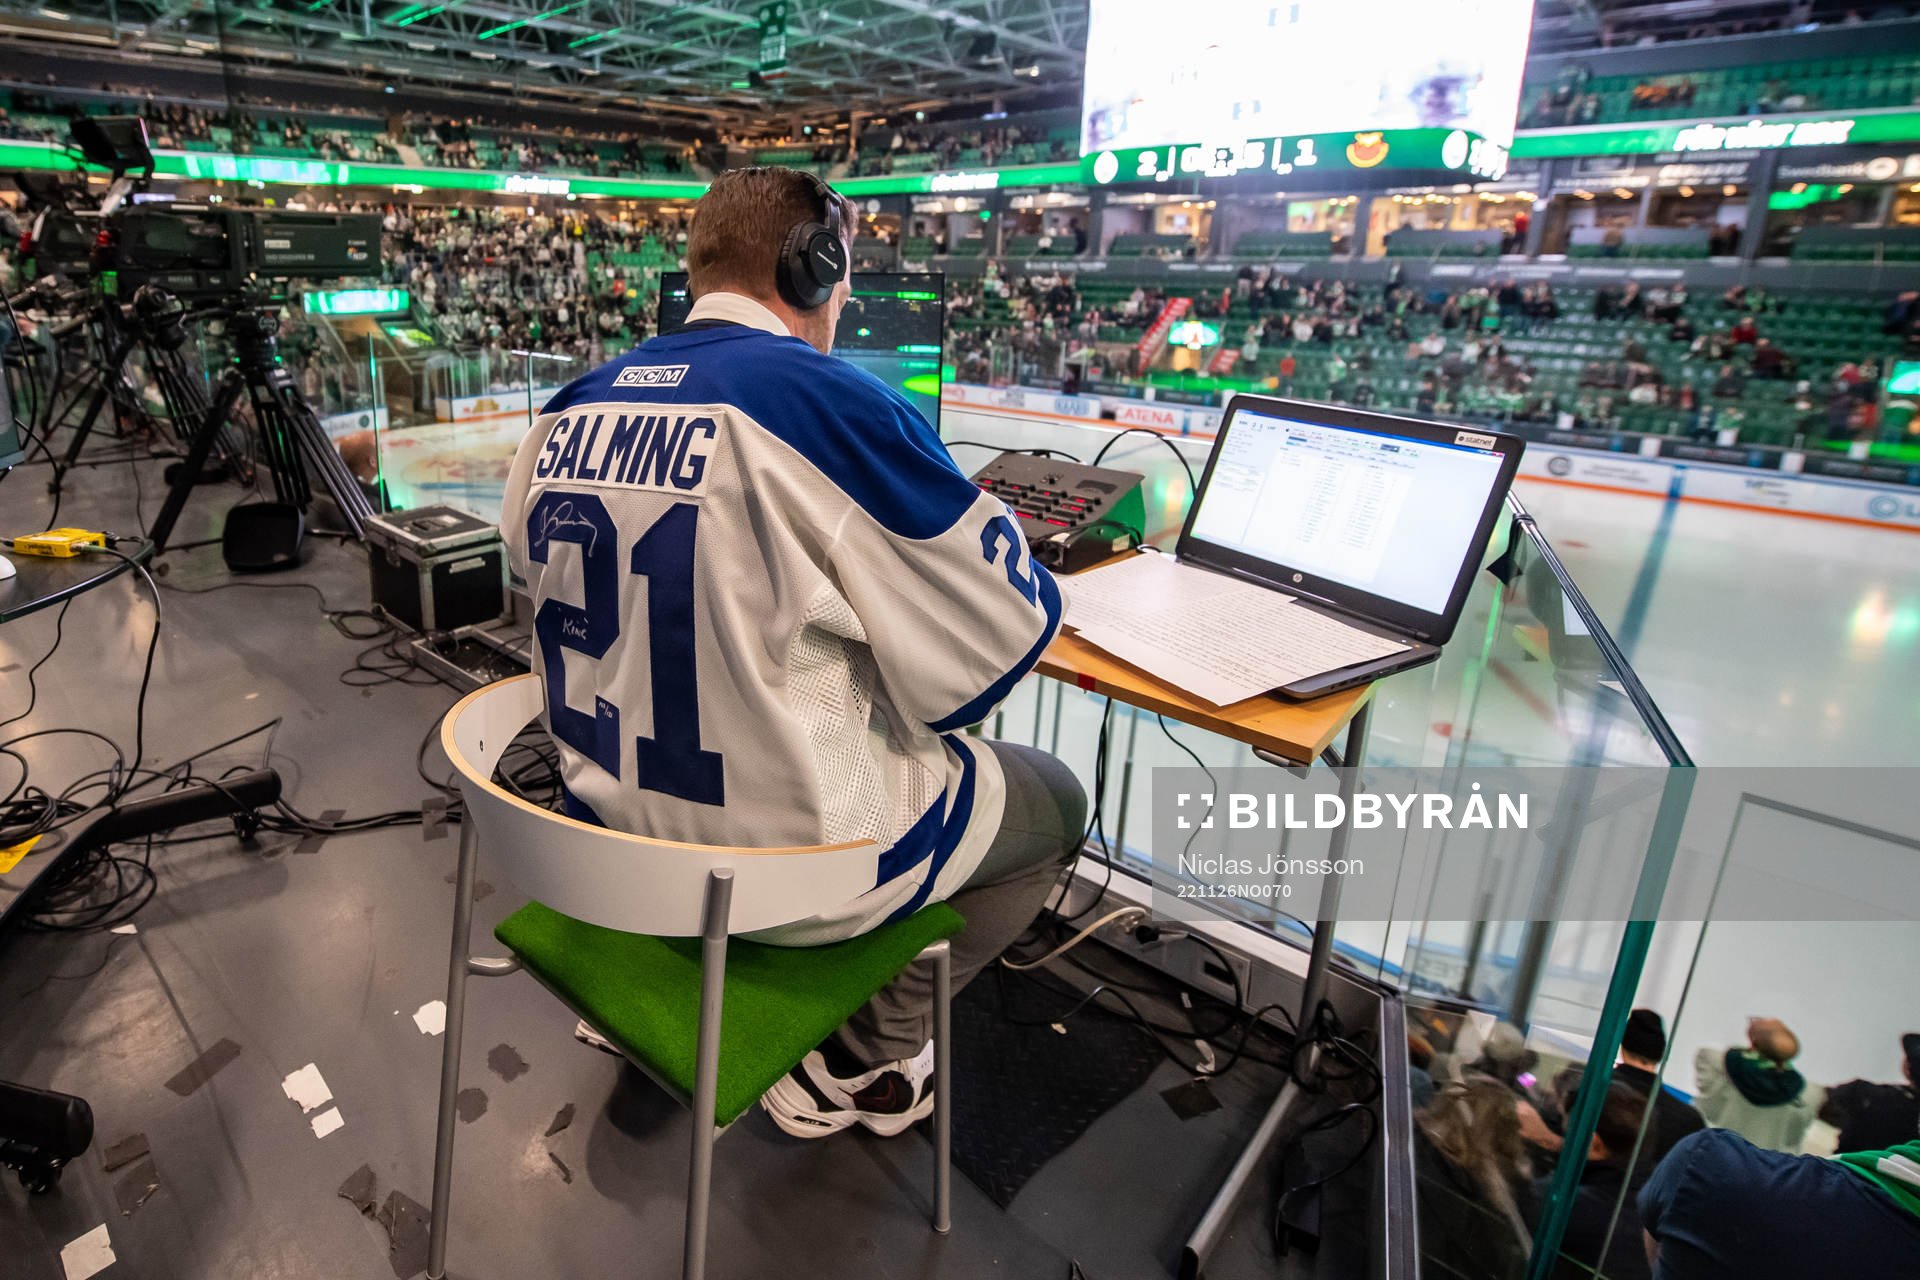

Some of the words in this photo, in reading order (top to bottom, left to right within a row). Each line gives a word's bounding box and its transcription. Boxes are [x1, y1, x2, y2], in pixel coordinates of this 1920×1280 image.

[618, 367, 686, 384] CCM
[536, 414, 717, 490] SALMING
[1465, 436, 1493, 446] statnet
[980, 505, 1036, 608] 2
[527, 490, 725, 807] 21
